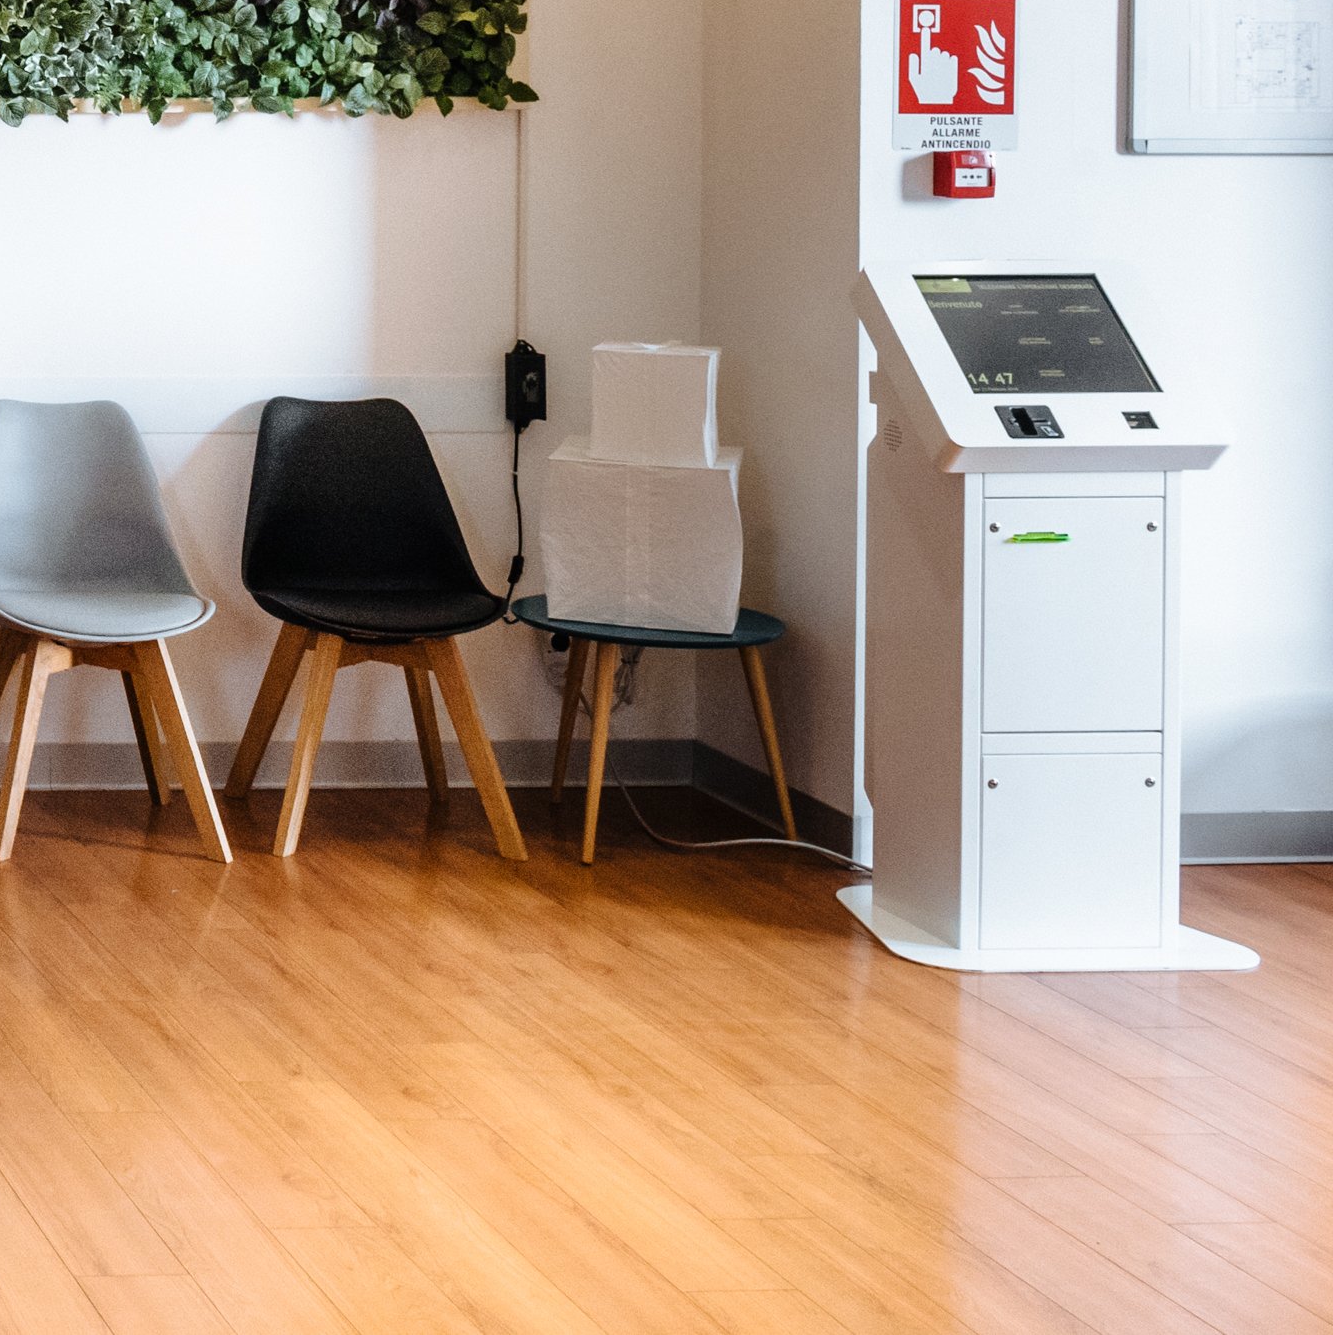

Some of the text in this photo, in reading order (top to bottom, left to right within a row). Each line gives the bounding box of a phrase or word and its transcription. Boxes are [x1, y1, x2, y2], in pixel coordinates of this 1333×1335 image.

[929, 116, 983, 126] PULSANTE
[932, 128, 981, 137] ALLARME
[921, 140, 991, 149] ANTINCENDIO
